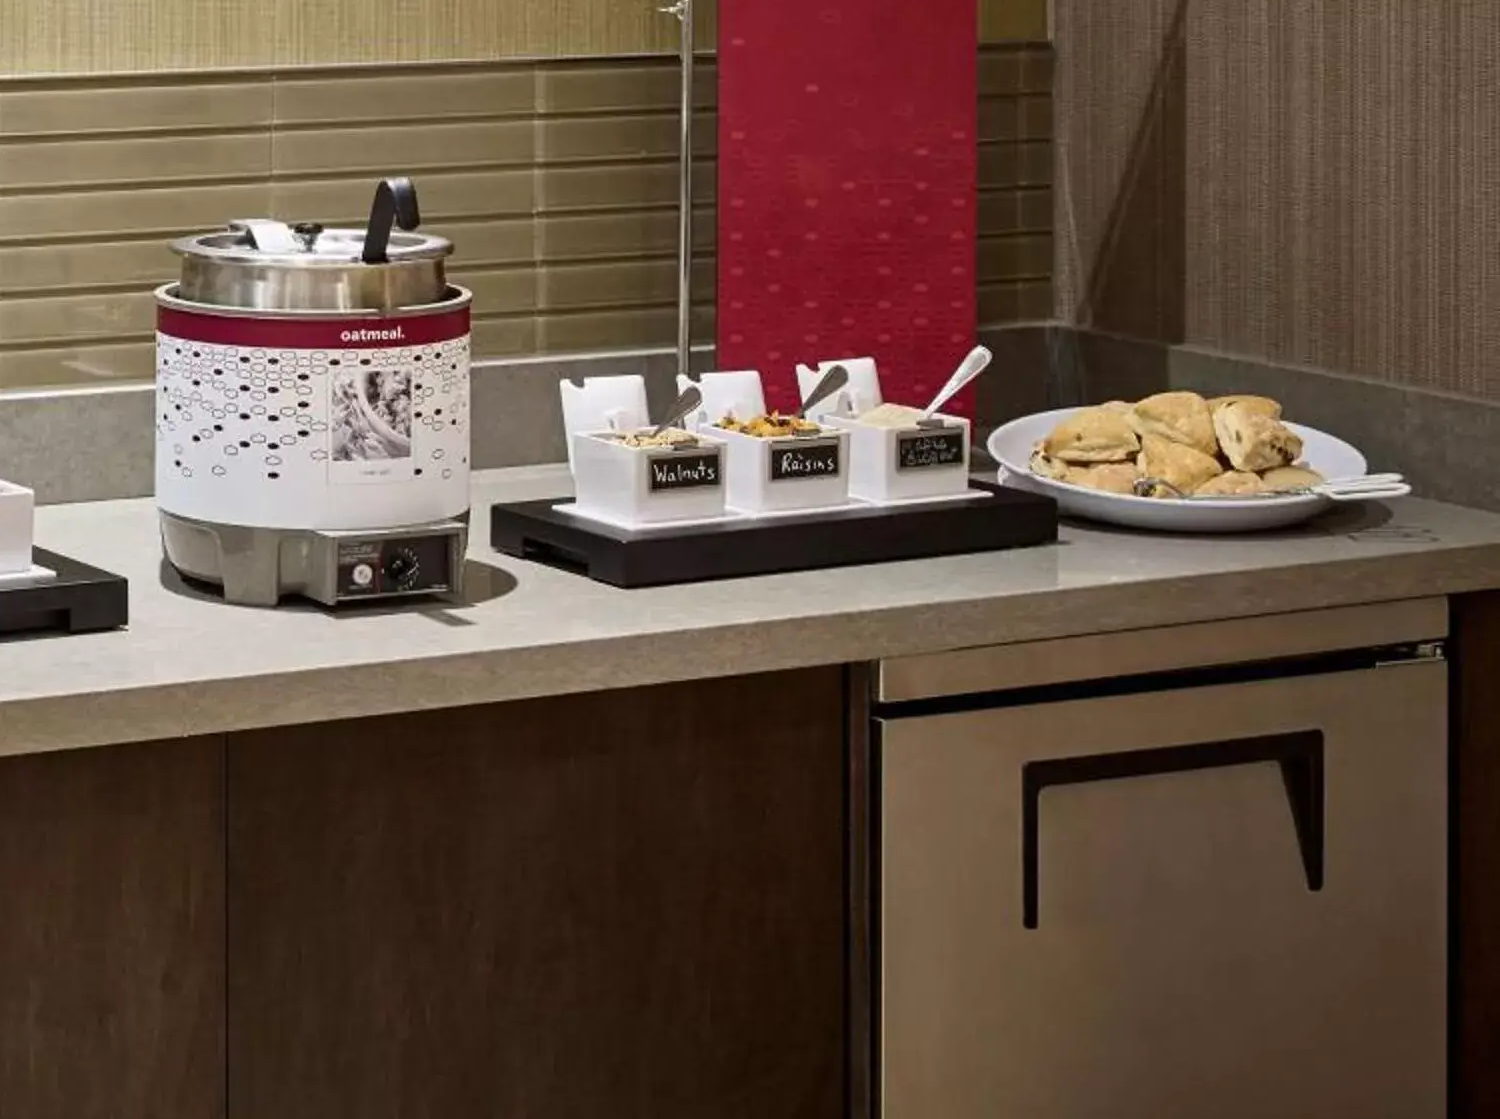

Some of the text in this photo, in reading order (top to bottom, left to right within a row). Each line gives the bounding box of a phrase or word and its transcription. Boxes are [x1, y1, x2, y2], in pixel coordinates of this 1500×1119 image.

[340, 325, 405, 342] oatmeal.
[653, 460, 716, 483] Walnuts
[781, 452, 836, 474] Raisins
